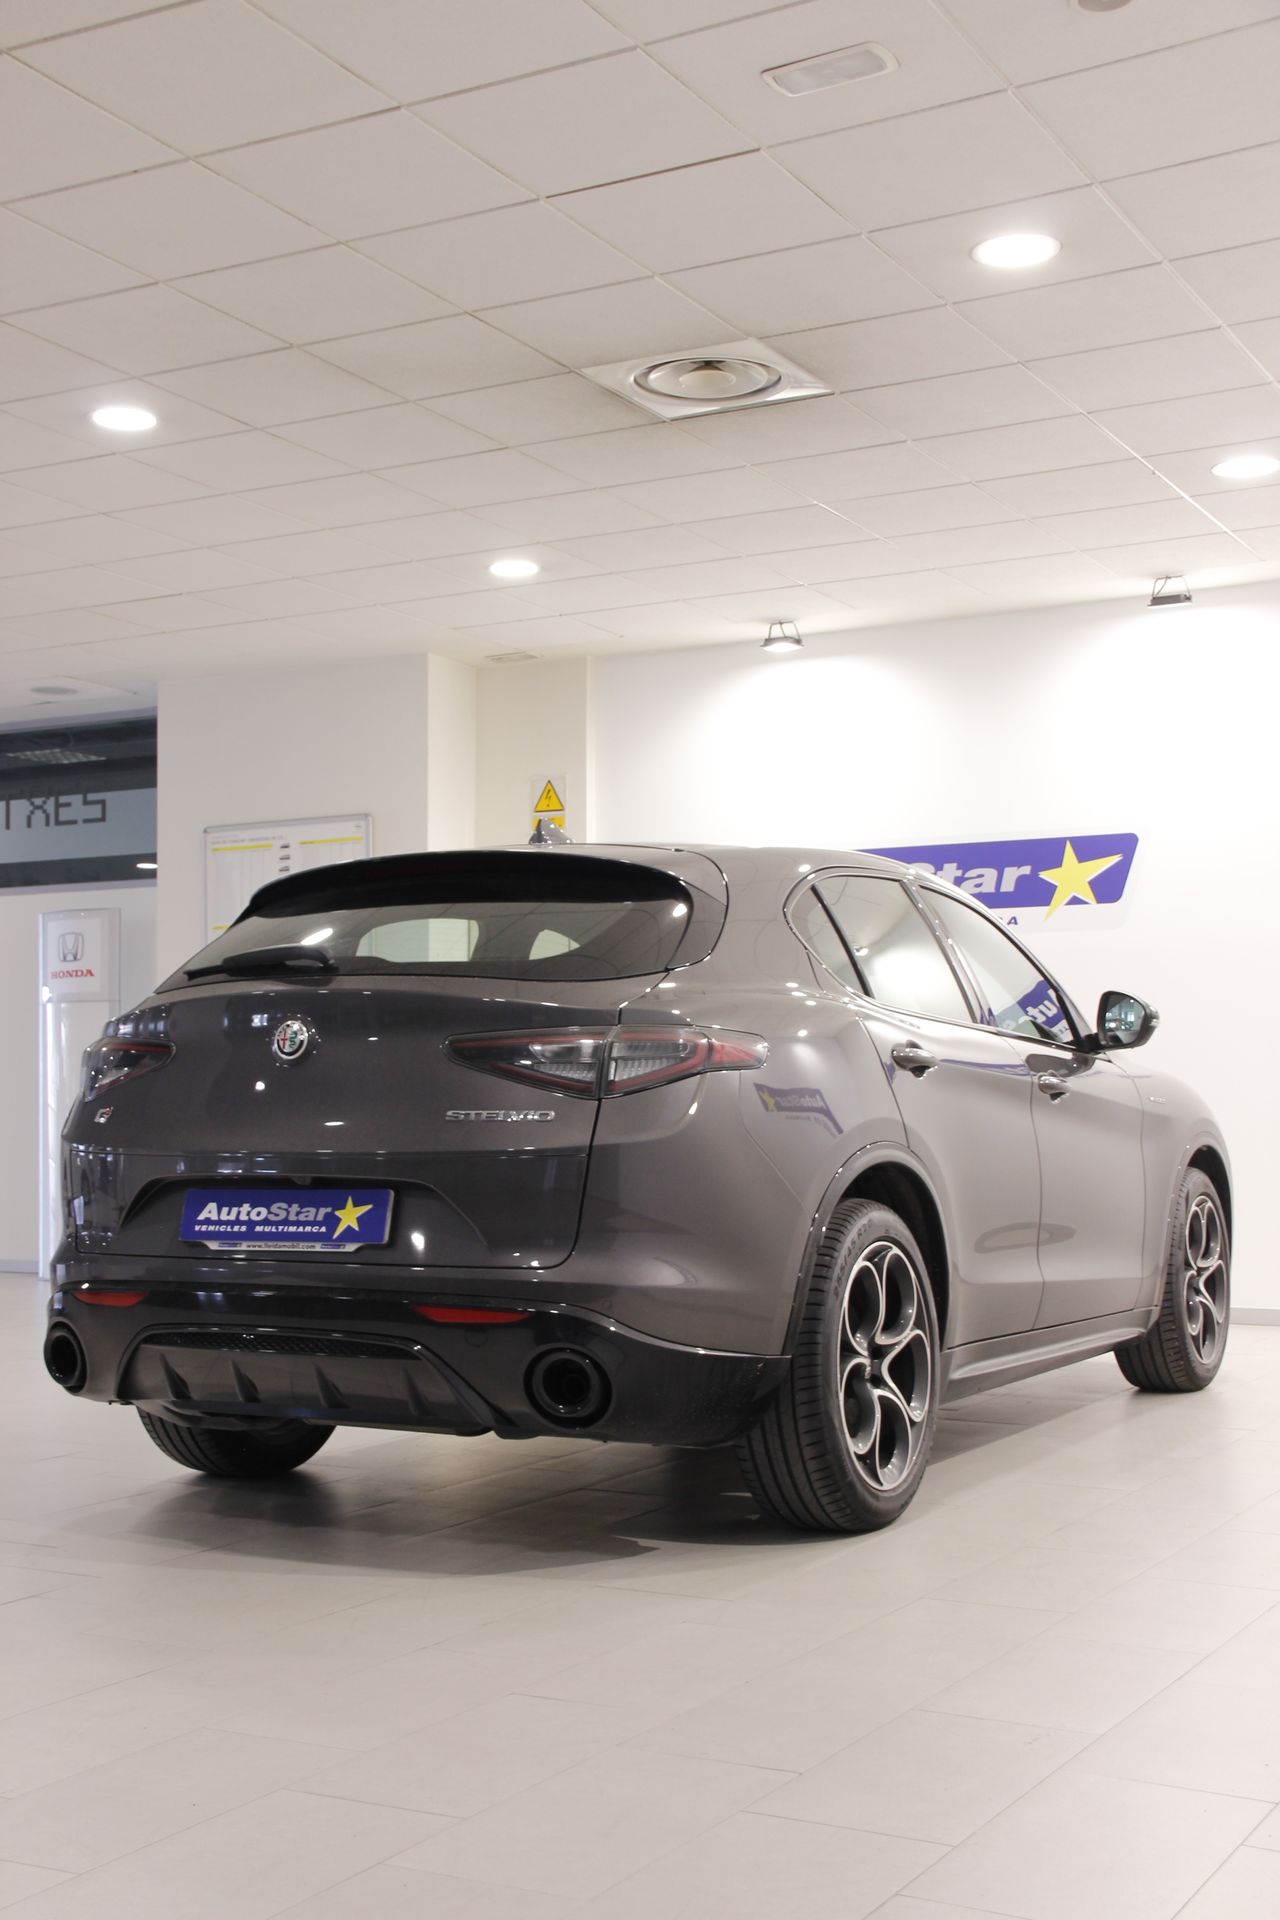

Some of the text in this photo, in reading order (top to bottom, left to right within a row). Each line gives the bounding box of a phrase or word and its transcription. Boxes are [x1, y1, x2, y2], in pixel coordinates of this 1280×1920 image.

[51, 968, 95, 980] HONDA
[196, 1202, 332, 1221] AutoStar
[194, 1224, 327, 1233] VEHICLES MULTIMARCA
